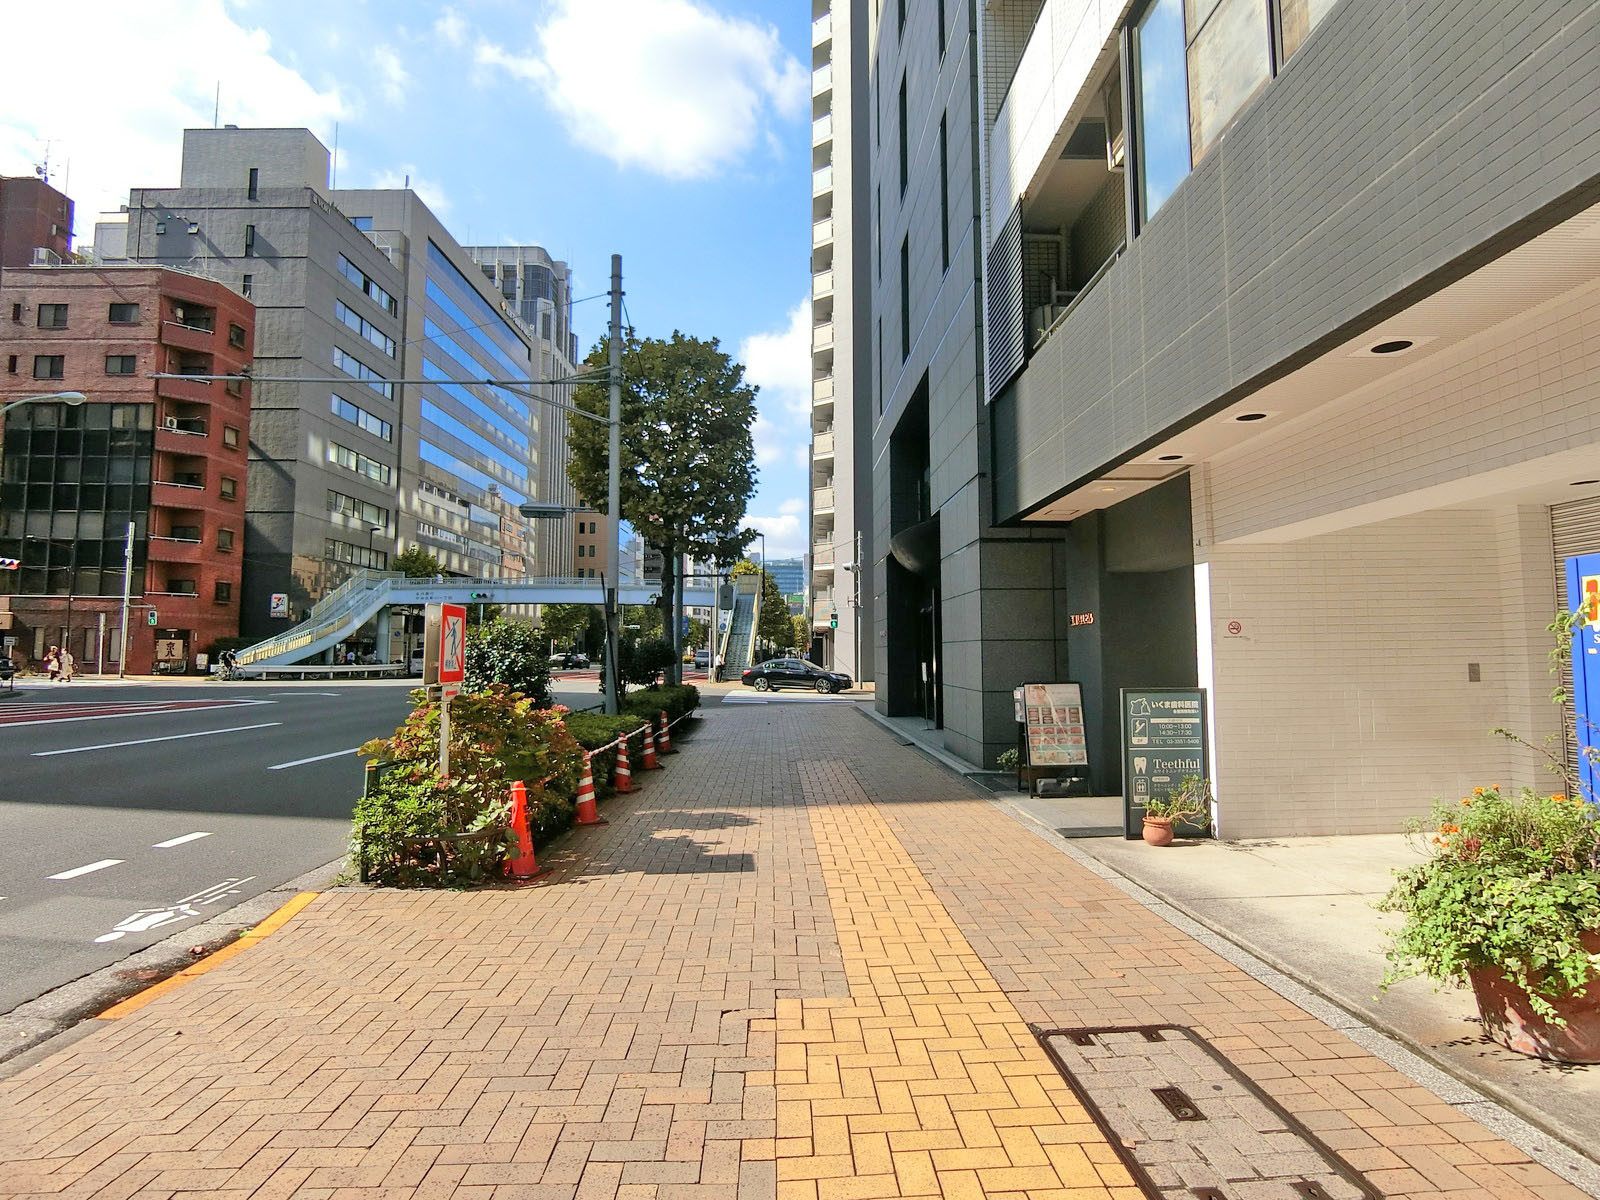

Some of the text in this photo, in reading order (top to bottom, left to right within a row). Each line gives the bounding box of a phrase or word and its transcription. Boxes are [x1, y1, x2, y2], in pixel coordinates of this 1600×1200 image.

[1151, 701, 1199, 709] いくま歯科医院
[1153, 758, 1200, 769] Teethful
